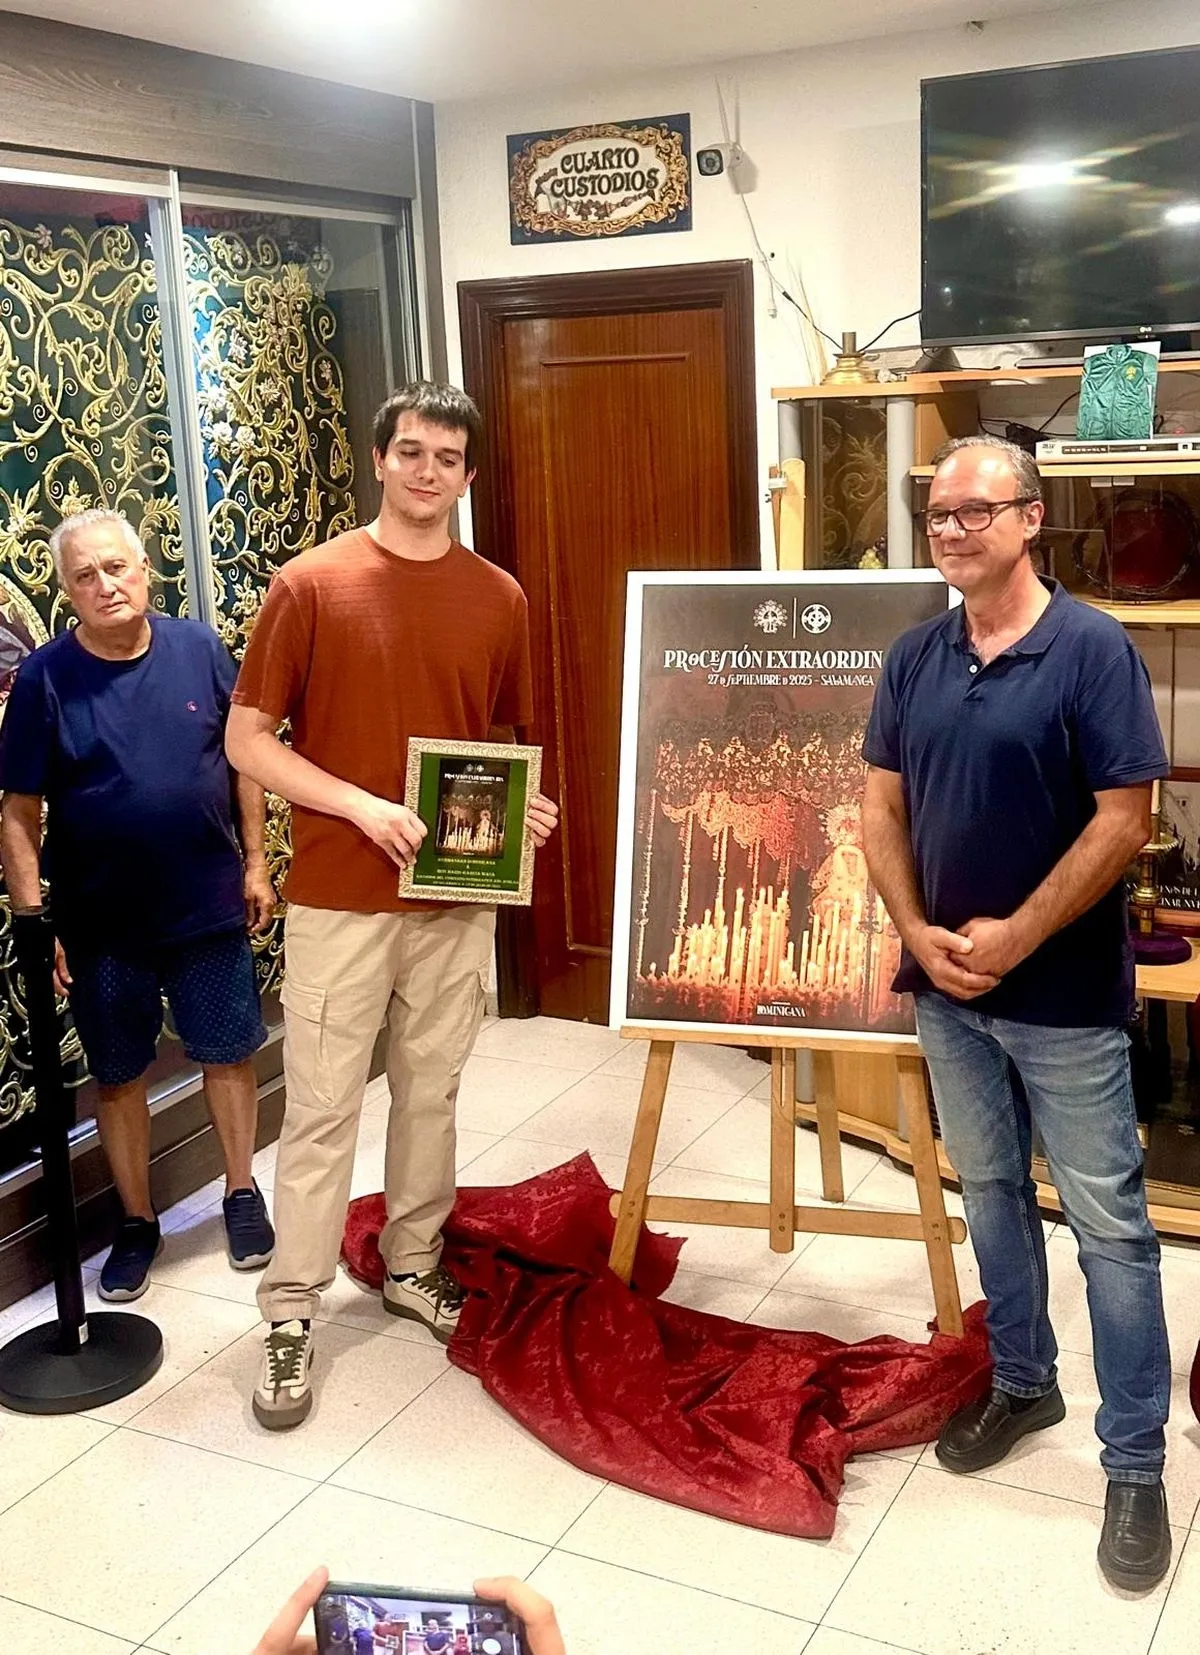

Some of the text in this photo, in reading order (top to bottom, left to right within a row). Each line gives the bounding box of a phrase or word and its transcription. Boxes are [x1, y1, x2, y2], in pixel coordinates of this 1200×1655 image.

[560, 147, 640, 174] CUARTO
[550, 168, 660, 198] CUSTODIOS
[664, 644, 763, 673] PROCESIÓN
[708, 674, 720, 685] 27
[722, 674, 781, 688] SEPTIEMBRE
[789, 674, 813, 686] 2025
